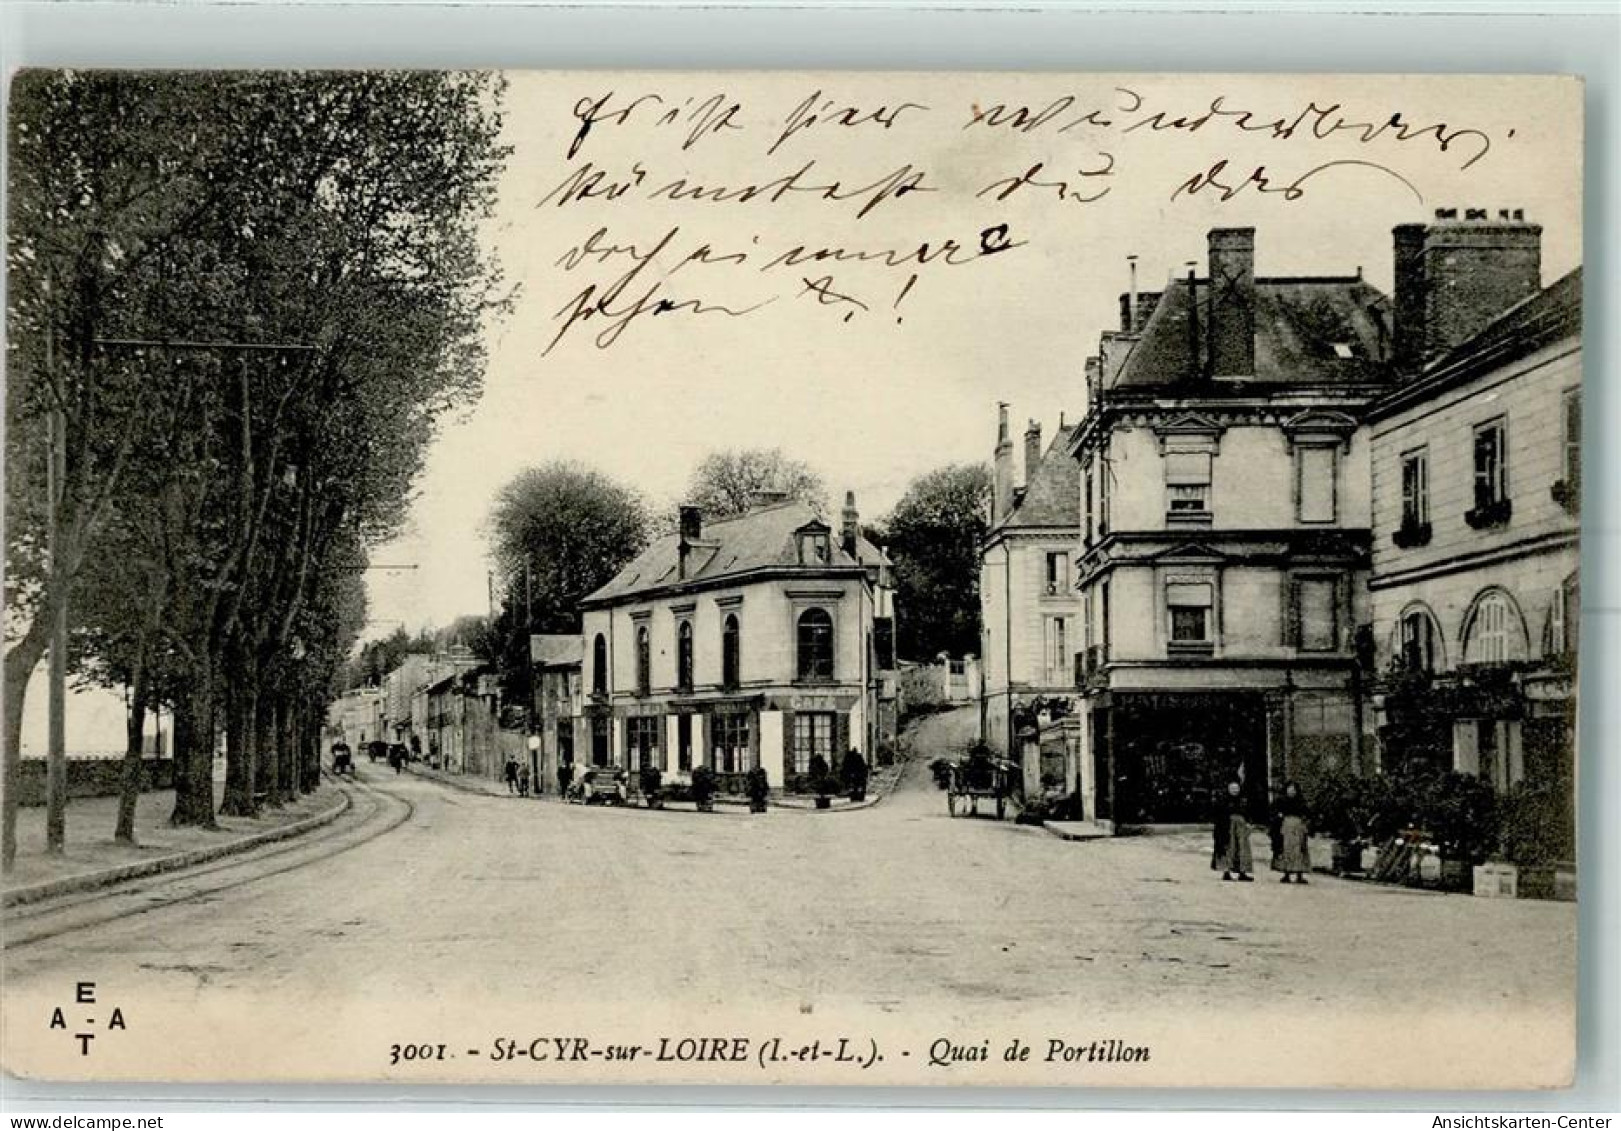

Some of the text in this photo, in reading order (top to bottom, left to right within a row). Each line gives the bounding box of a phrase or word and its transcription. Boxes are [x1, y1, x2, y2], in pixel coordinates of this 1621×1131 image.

[490, 1037, 750, 1062] St-CYR-sur-LOIRE
[928, 1037, 989, 1067] Quai
[1003, 1038, 1031, 1062] de
[1044, 1038, 1151, 1062] Portillon
